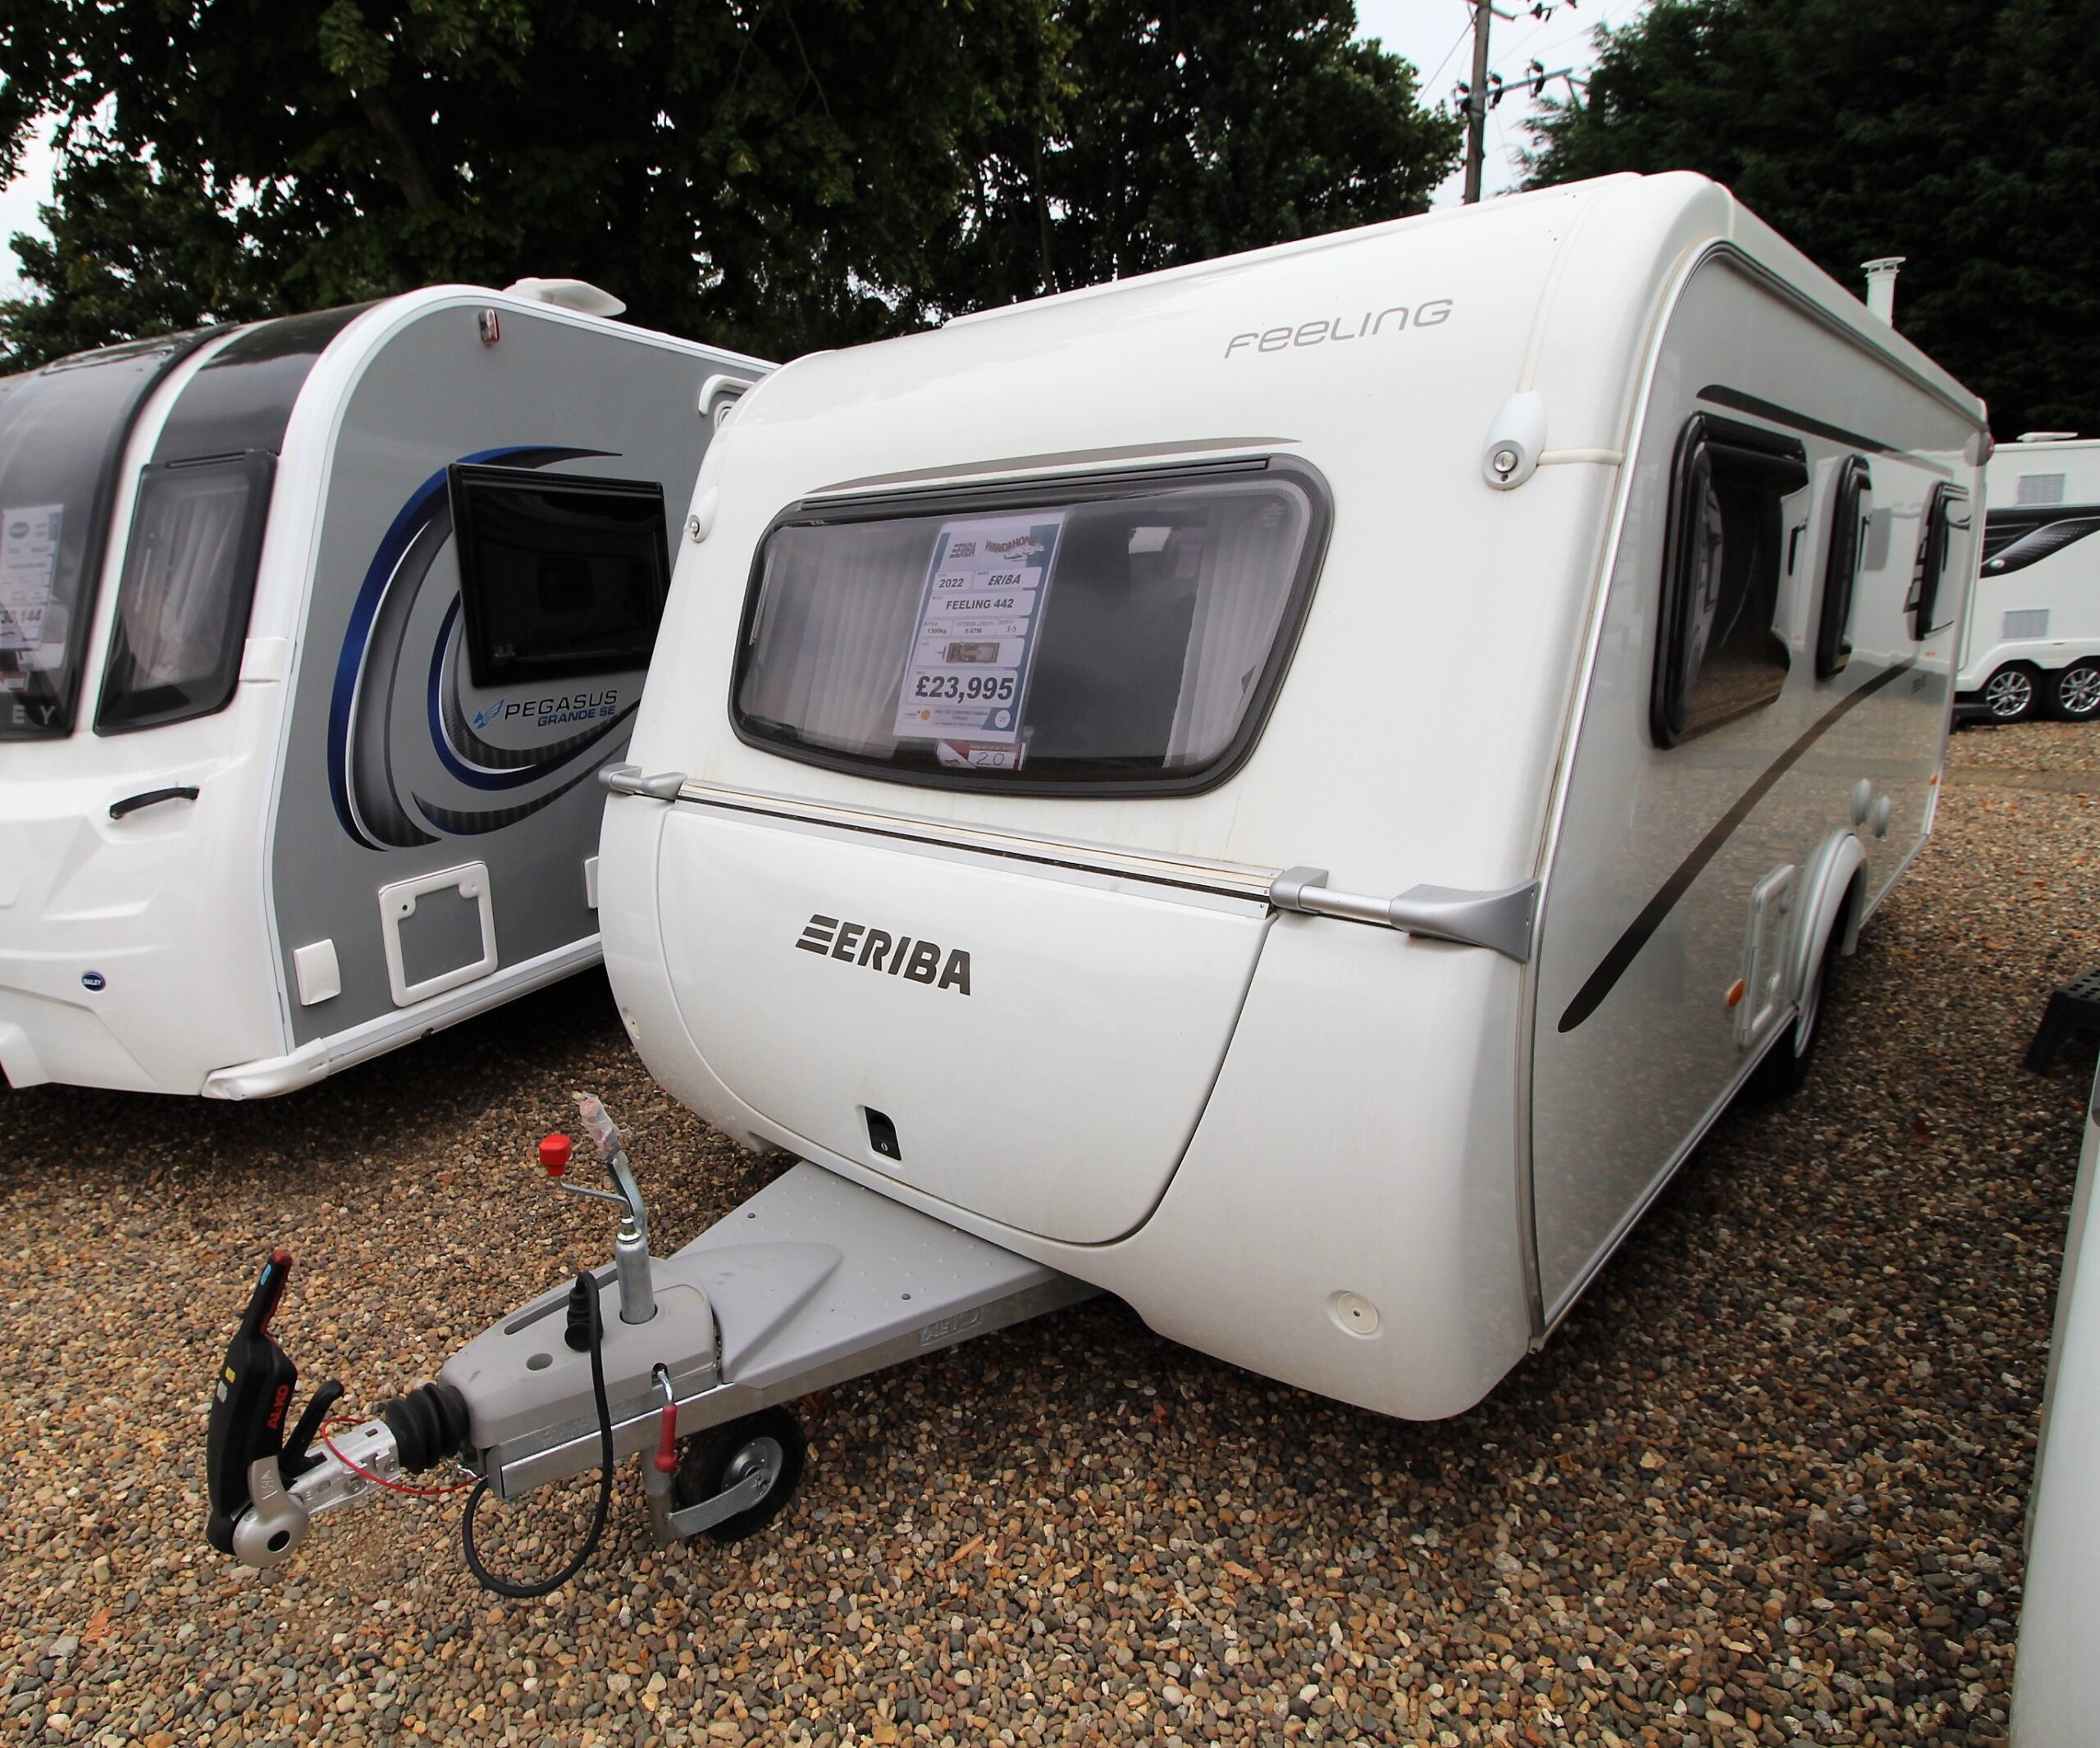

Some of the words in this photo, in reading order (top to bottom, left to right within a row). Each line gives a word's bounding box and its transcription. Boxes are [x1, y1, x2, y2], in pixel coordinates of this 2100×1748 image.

[938, 577, 965, 588] 2022
[988, 573, 1021, 586] ERIBA
[946, 599, 991, 610] FEELING
[993, 598, 1015, 609] 442
[915, 675, 1015, 704] £23,995
[504, 690, 618, 719] PEGASUS
[537, 707, 596, 728] GRANDE
[599, 705, 616, 717] SE
[976, 751, 1005, 767] 20
[831, 920, 970, 996] ERIBA
